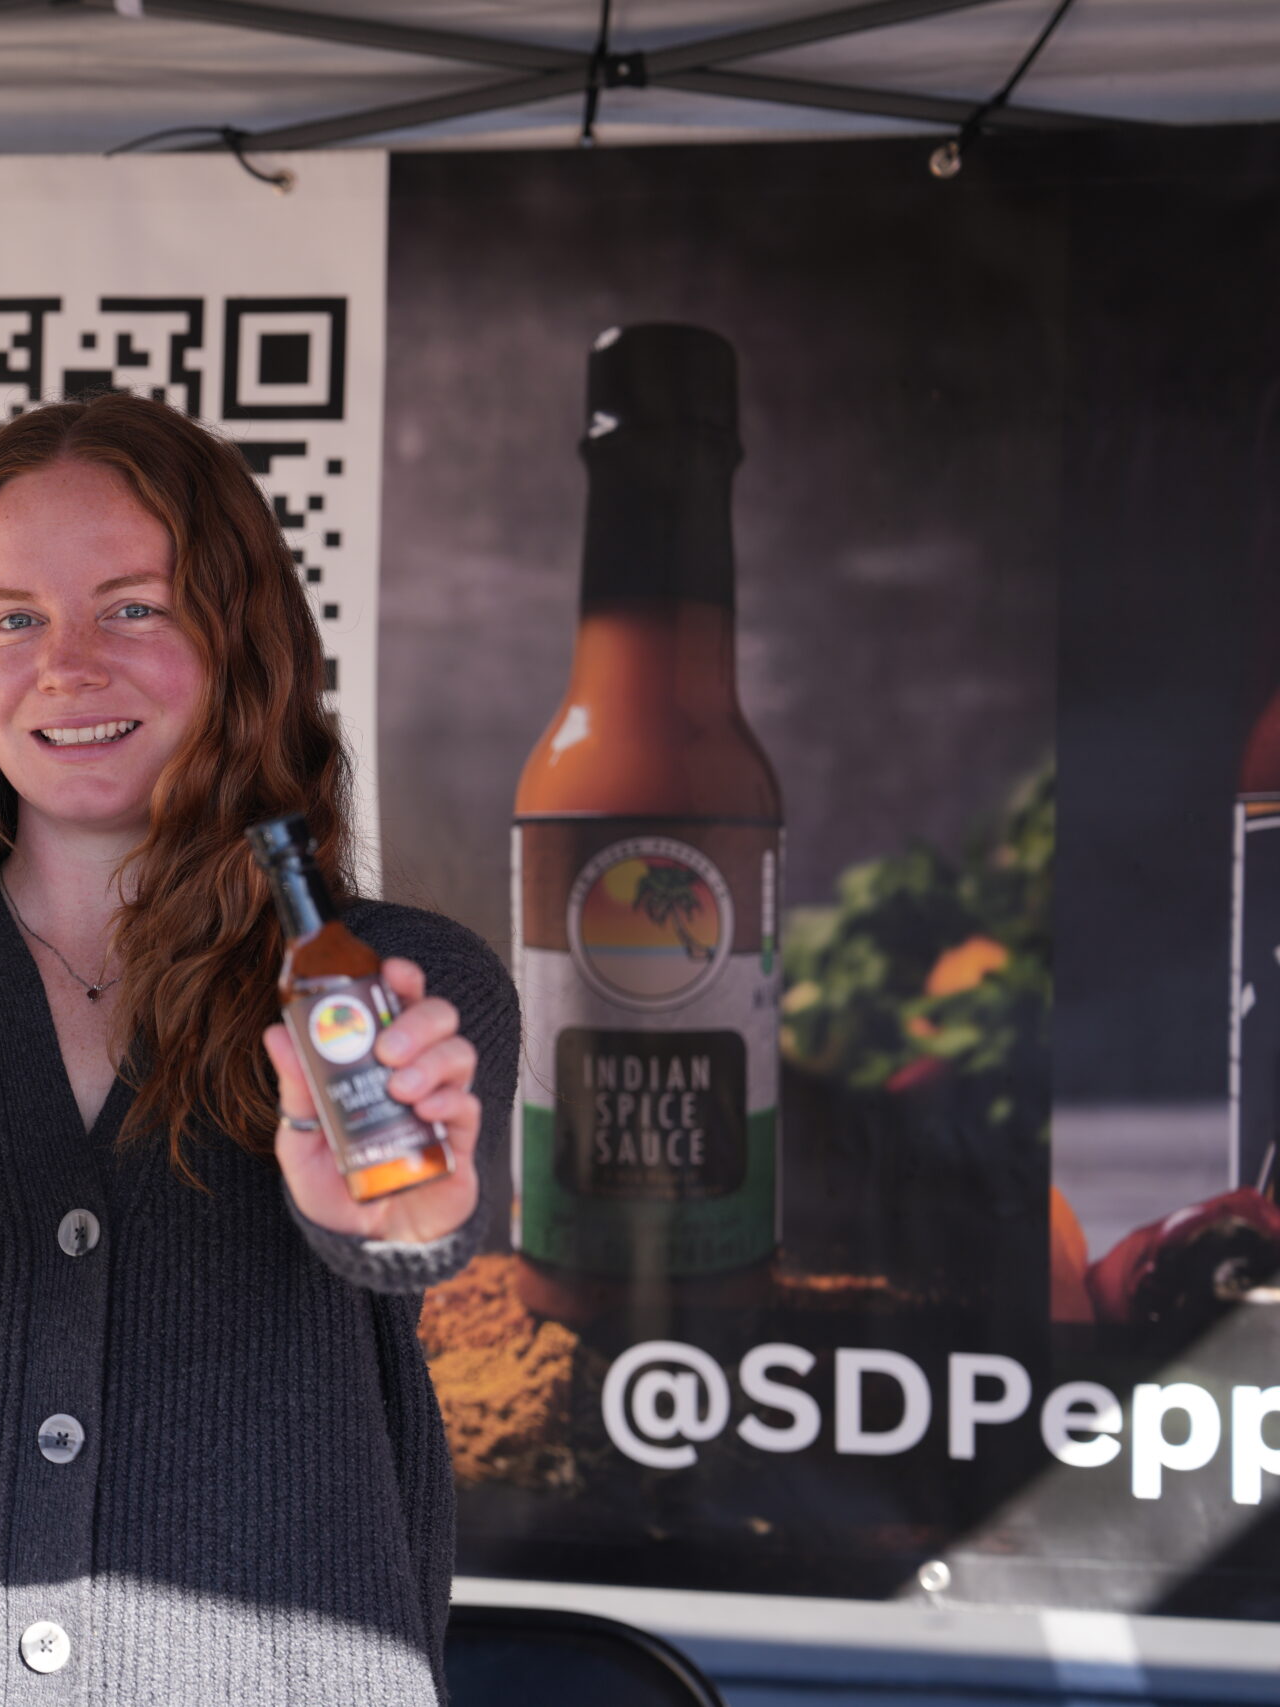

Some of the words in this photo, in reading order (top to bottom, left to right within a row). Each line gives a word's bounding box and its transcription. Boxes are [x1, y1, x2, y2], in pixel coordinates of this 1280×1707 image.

[582, 1054, 712, 1092] INDIAN
[595, 1091, 698, 1130] SPICE
[594, 1128, 706, 1168] SAUCE
